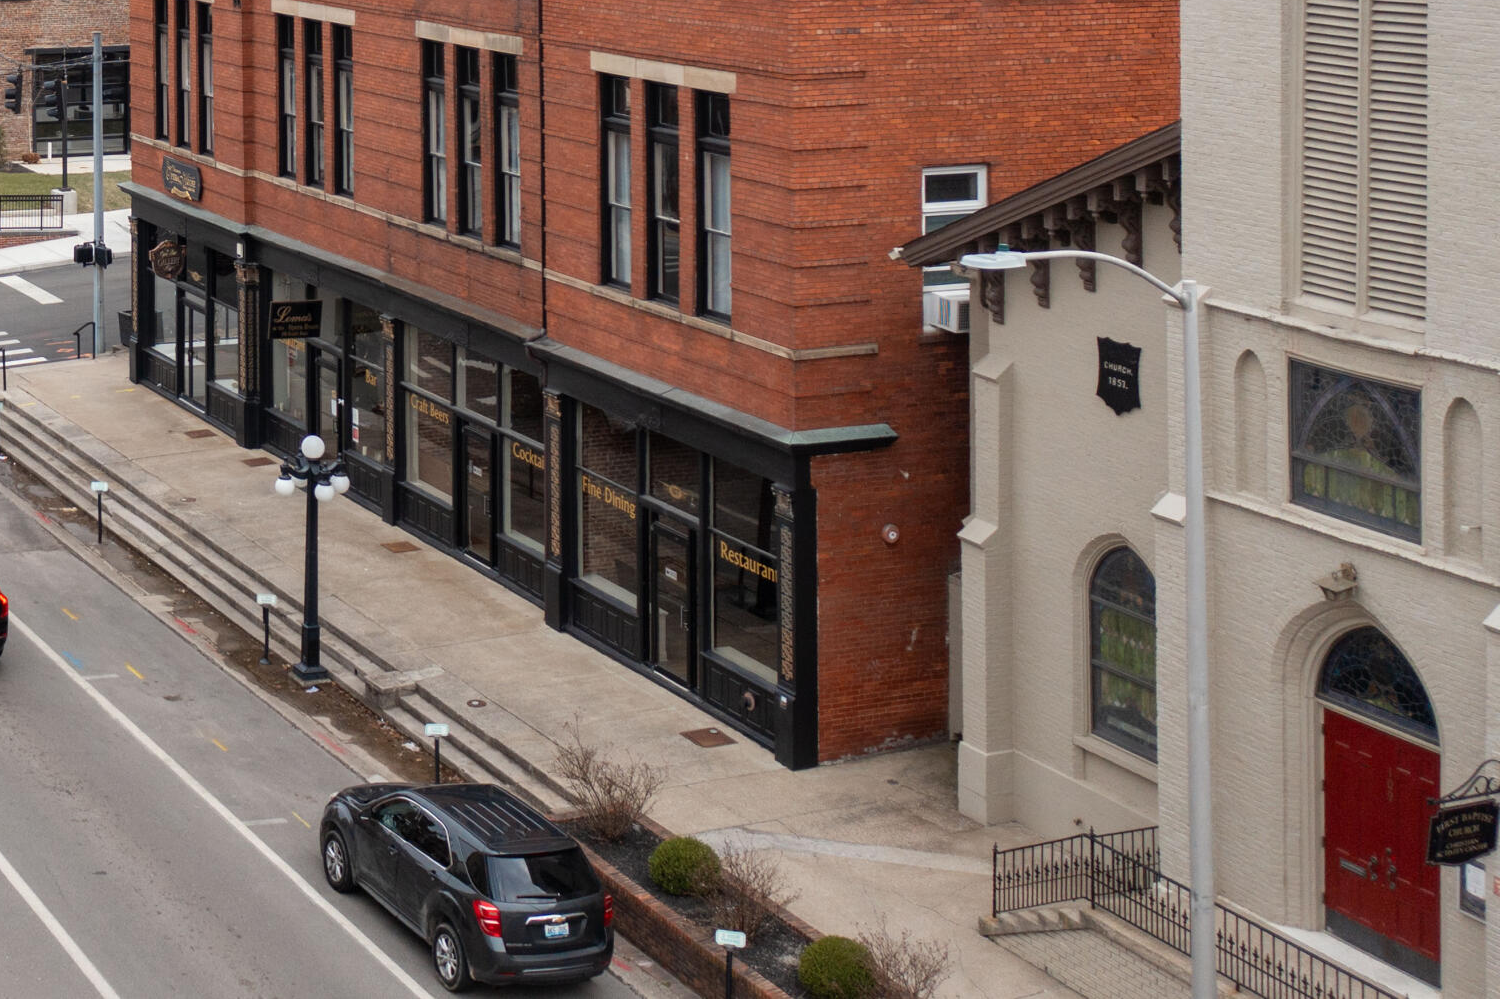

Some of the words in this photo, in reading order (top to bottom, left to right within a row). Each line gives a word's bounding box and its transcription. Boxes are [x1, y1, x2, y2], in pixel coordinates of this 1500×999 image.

[365, 368, 377, 386] Bar
[410, 393, 430, 415] Craft
[430, 403, 450, 425] Beers
[513, 442, 545, 470] Cocktai
[582, 475, 602, 499] Fine
[604, 486, 636, 519] Dining
